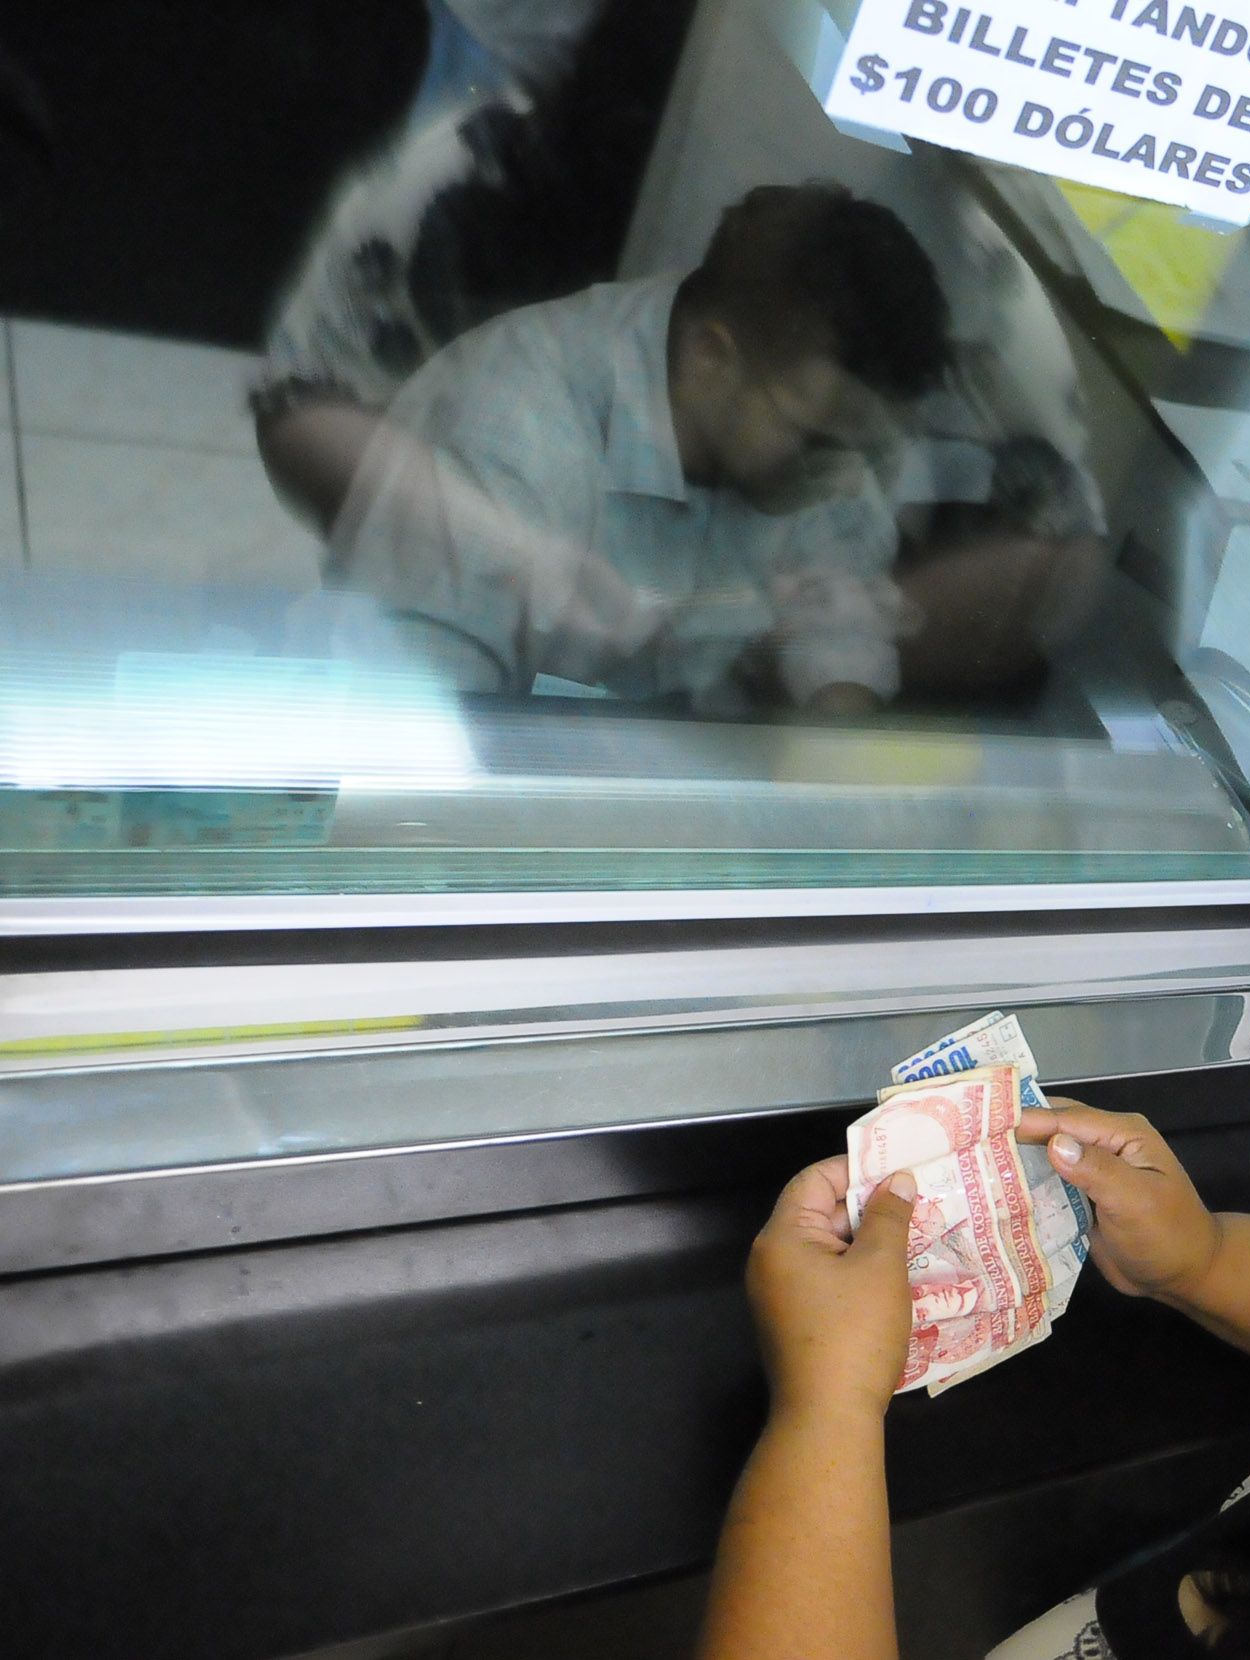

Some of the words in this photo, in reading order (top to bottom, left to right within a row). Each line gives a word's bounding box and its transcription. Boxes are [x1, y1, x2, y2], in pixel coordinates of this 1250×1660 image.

[902, 0, 1184, 107] BILLETES
[849, 53, 999, 124] $100
[958, 1152, 976, 1187] RICA
[991, 1134, 1007, 1170] RICA
[966, 1188, 986, 1232] COSTA
[984, 1260, 1009, 1310] ENTRAL
[1014, 1238, 1041, 1296] CENTRAL
